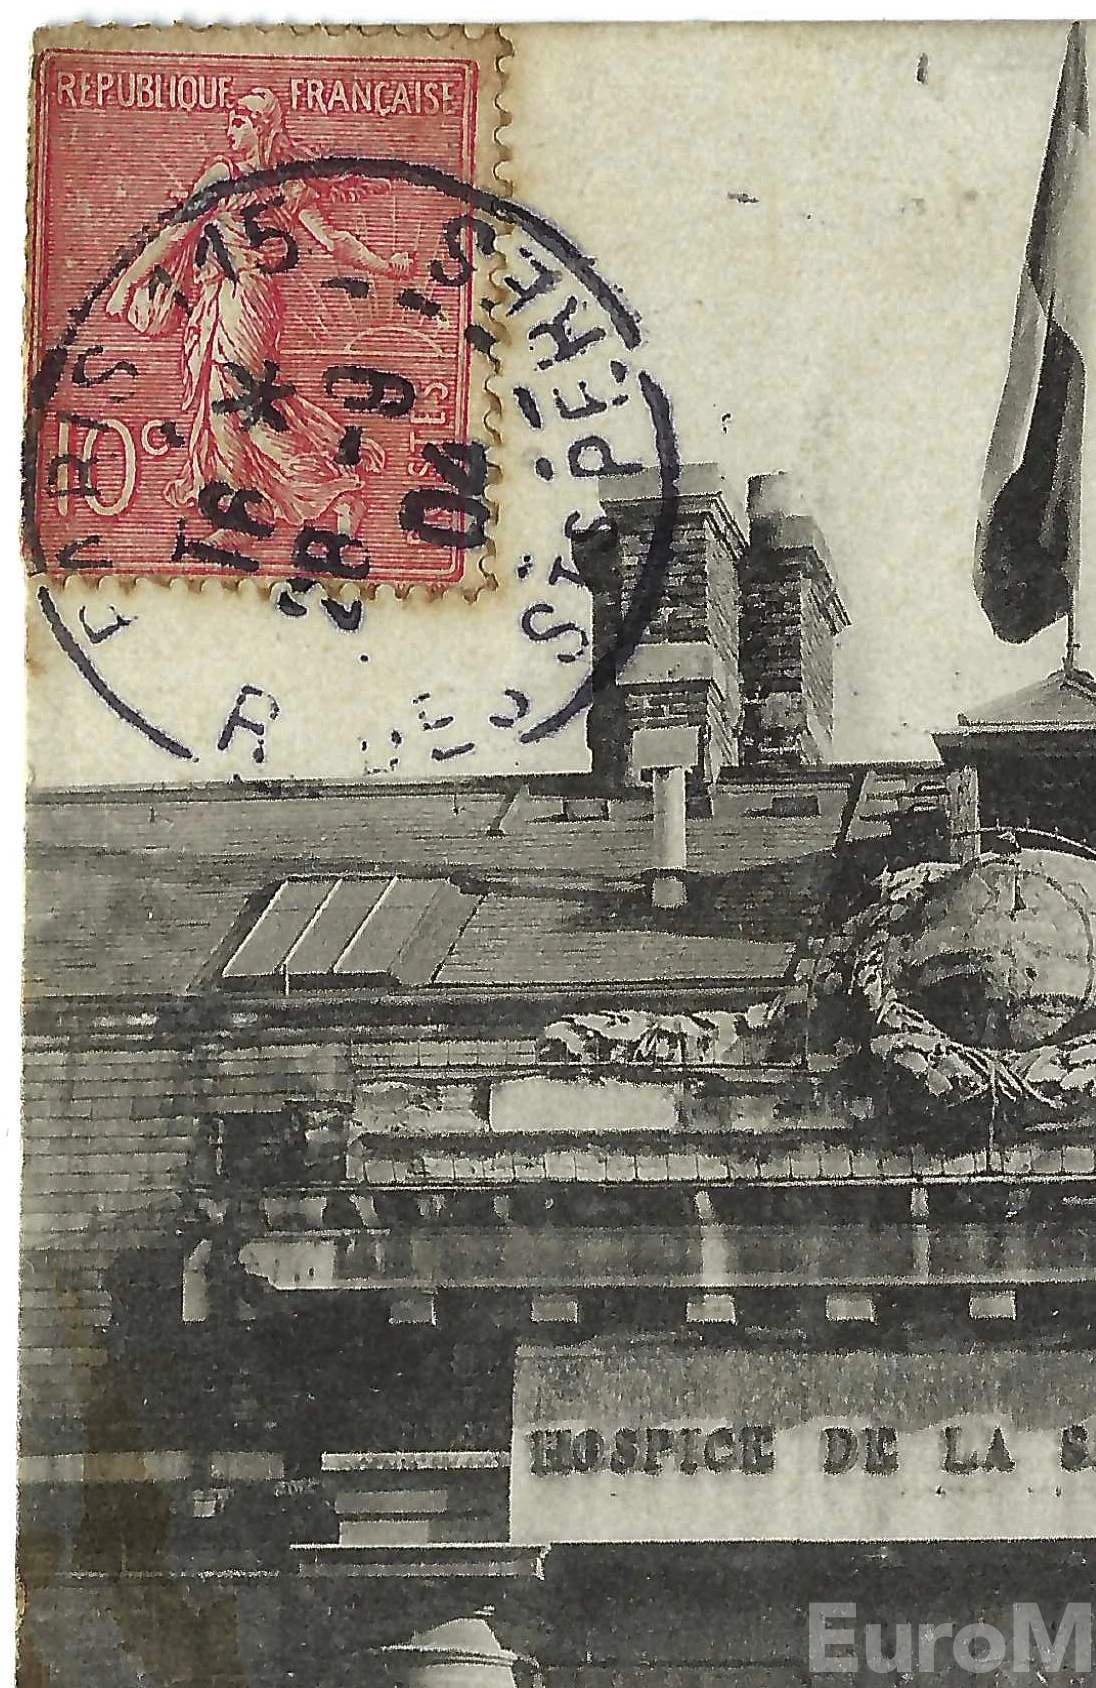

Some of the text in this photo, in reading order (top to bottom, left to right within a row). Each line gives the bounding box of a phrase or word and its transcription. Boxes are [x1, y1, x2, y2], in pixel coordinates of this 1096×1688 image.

[56, 71, 457, 117] REPUBLIQUE FRANÇAISE
[527, 1426, 777, 1475] HOSPICE
[821, 1425, 899, 1475] DE
[941, 1424, 1017, 1474] LA
